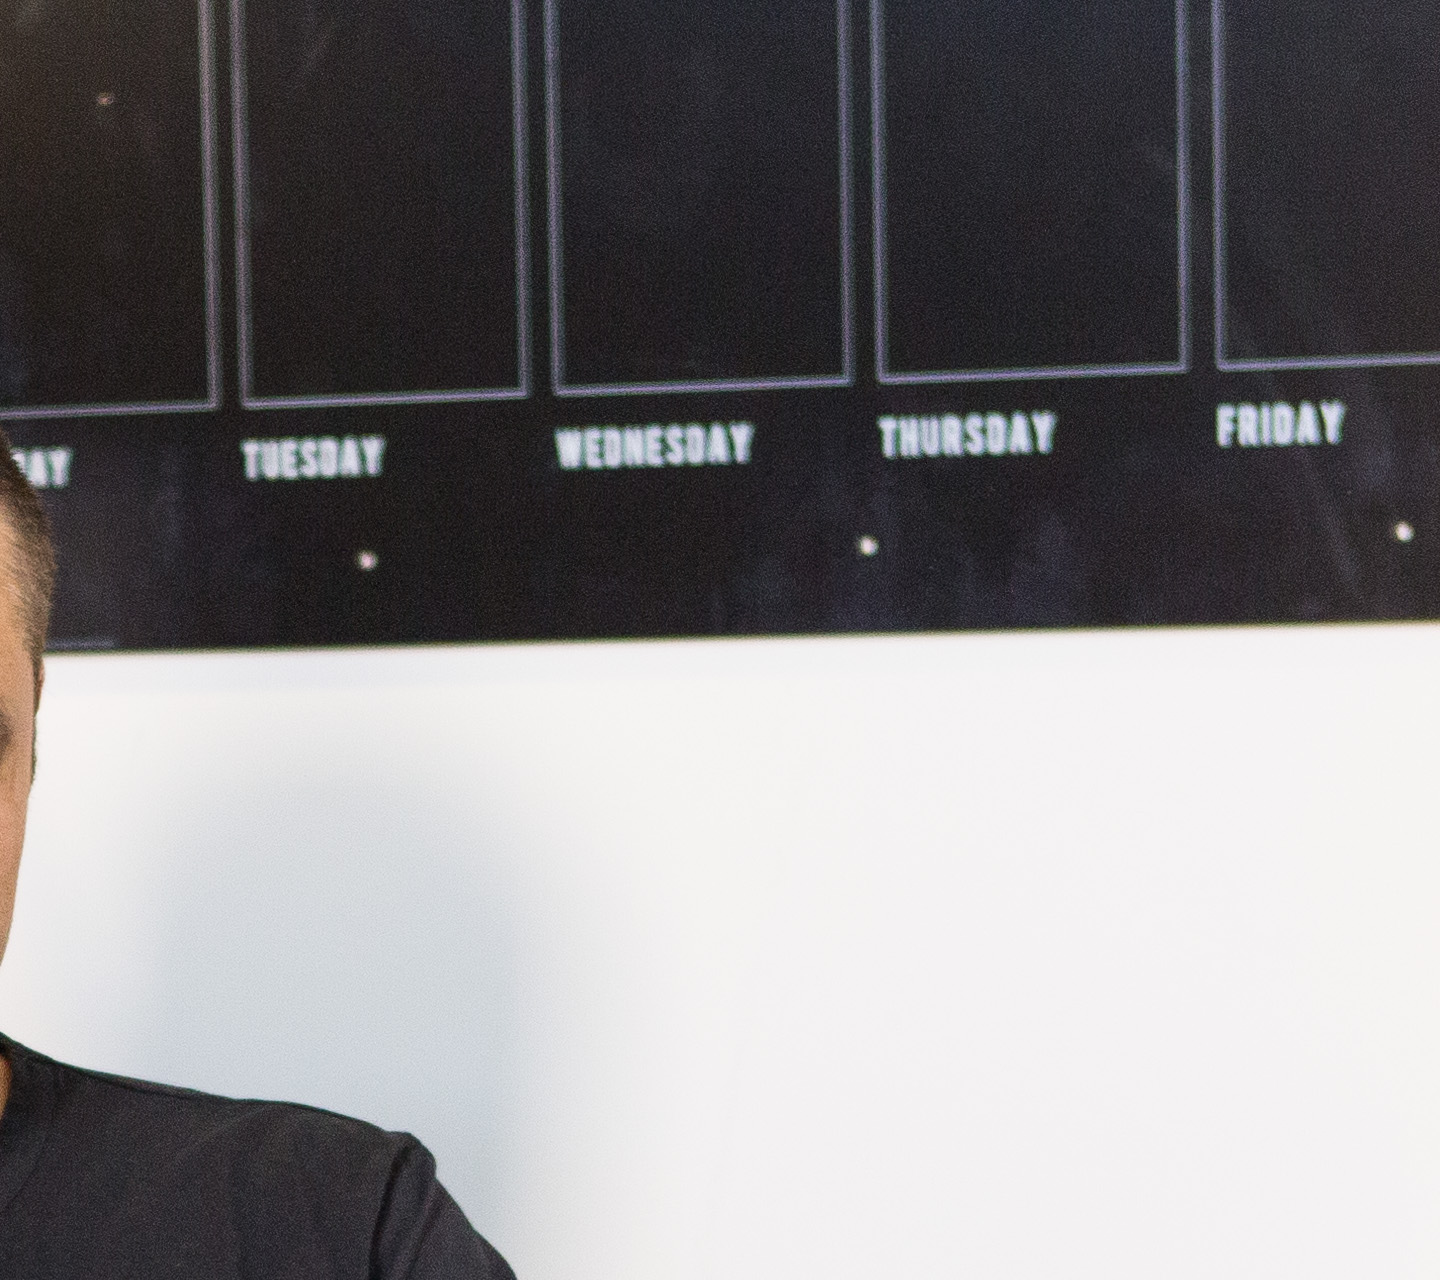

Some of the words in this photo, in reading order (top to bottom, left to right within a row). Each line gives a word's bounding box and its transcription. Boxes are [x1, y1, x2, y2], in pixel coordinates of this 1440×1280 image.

[555, 422, 754, 470] WEDNESDAY
[878, 411, 1057, 459] THURSDAY
[1216, 400, 1345, 448] FRIDAY
[241, 435, 386, 481] TUESDAY
